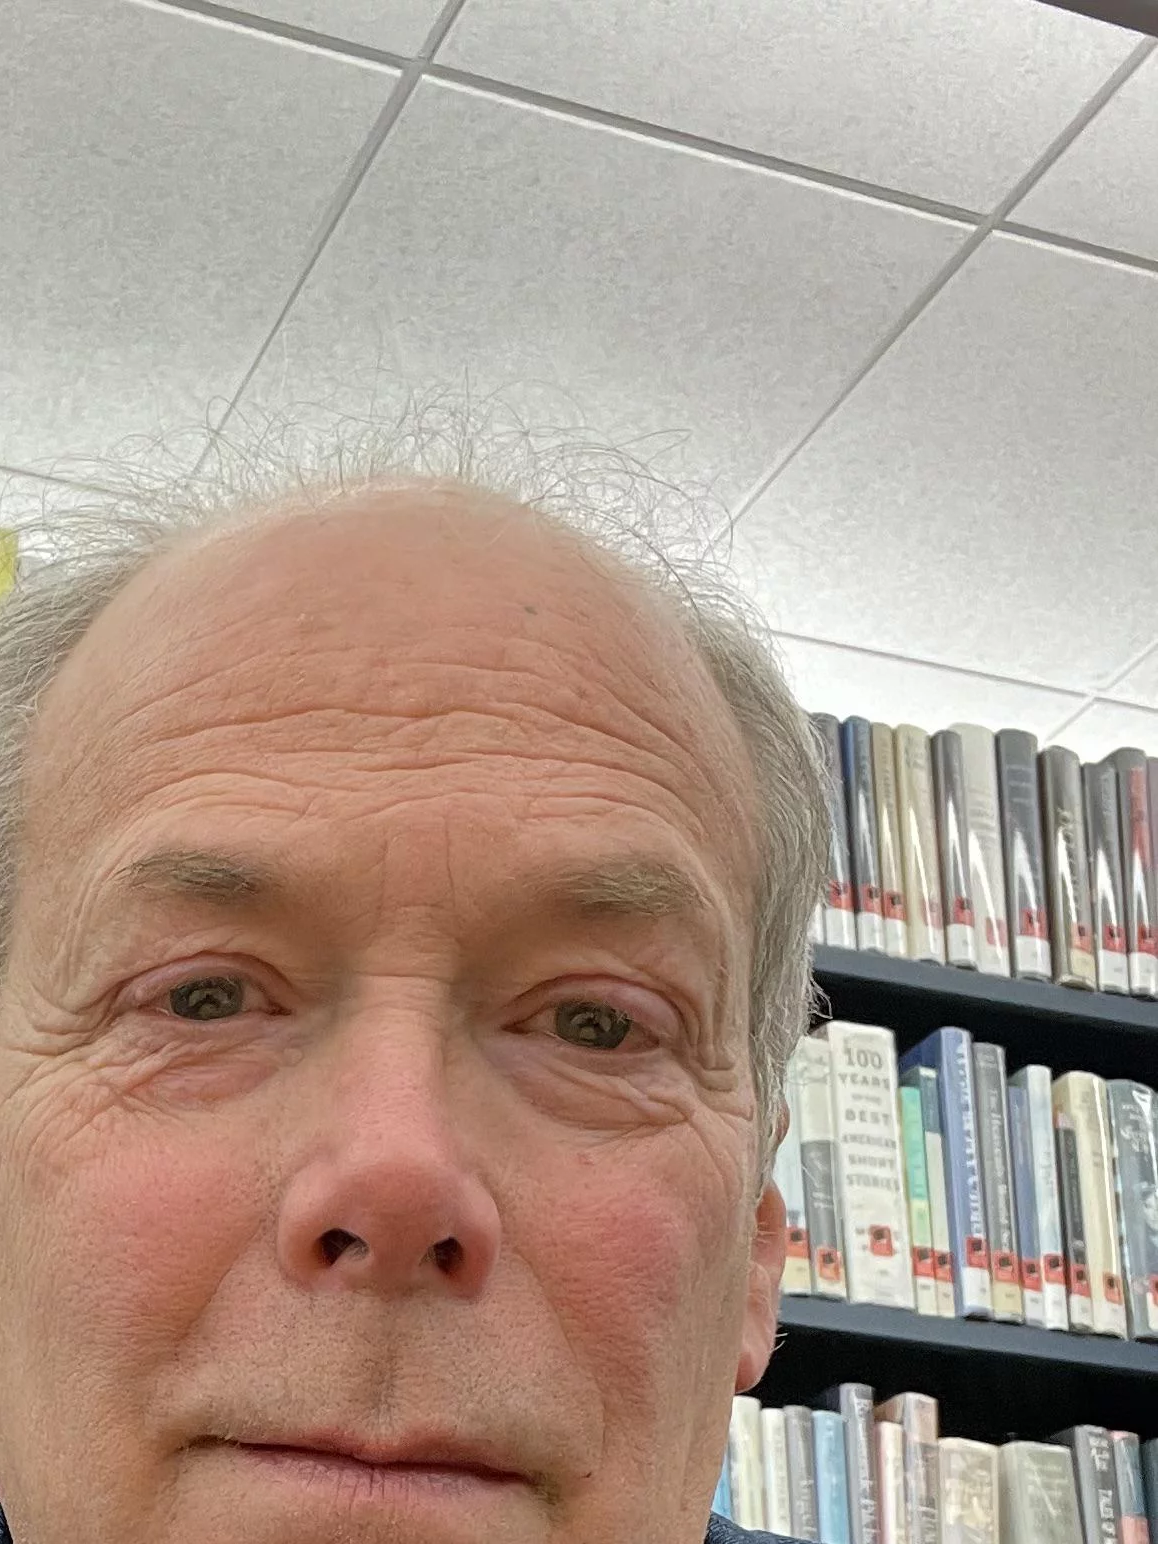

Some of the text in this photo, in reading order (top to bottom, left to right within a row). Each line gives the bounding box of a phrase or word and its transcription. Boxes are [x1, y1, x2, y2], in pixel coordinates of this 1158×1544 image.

[844, 1047, 883, 1068] 100
[838, 1072, 890, 1089] YEARS
[845, 1108, 891, 1125] BEST
[843, 1133, 897, 1150] AMERICAN
[848, 1153, 896, 1168] SHORT
[846, 1173, 900, 1192] STORIES
